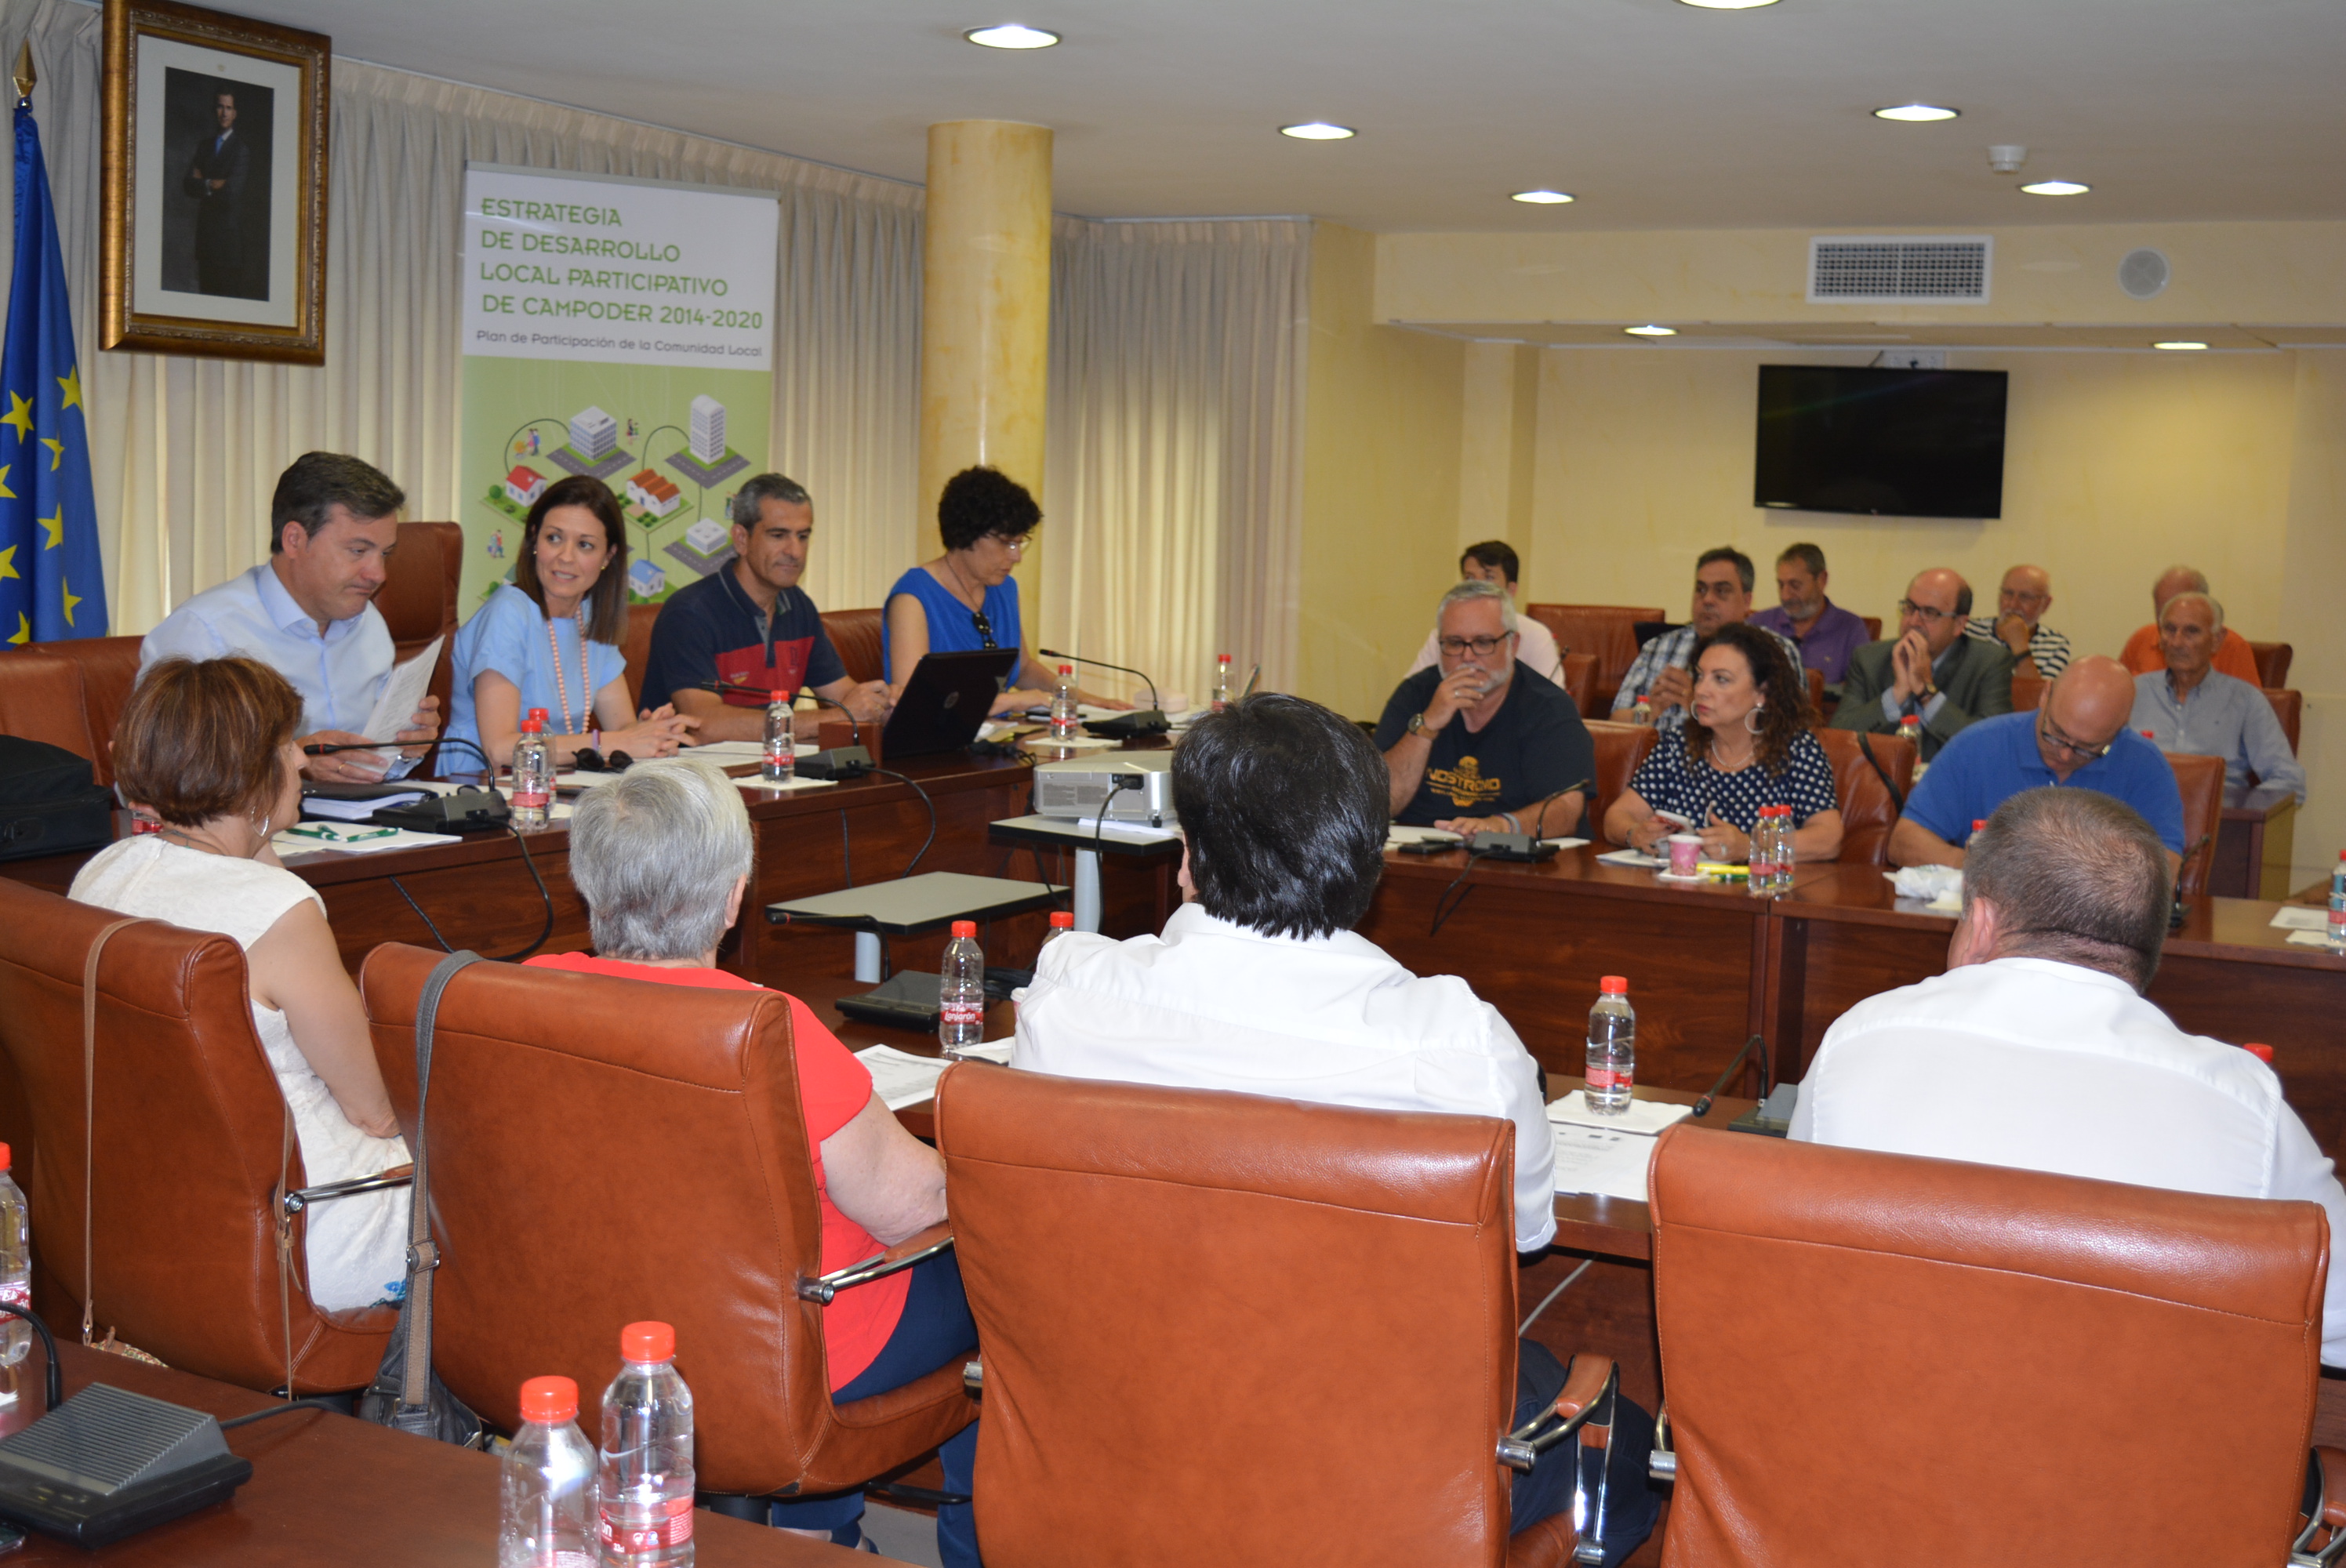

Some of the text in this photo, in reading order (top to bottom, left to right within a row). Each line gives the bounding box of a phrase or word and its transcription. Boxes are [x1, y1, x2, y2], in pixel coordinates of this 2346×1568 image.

[481, 198, 622, 226] ESTRATEGIA
[481, 230, 680, 262] DE DESARROLLO
[481, 262, 728, 296] LOCAL PARTICIPATIVO
[483, 295, 762, 328] DE CAMPODER 2014-2020
[477, 330, 763, 357] Plan de Participación de la Comunidad Local
[945, 1011, 975, 1022] Lanjarón
